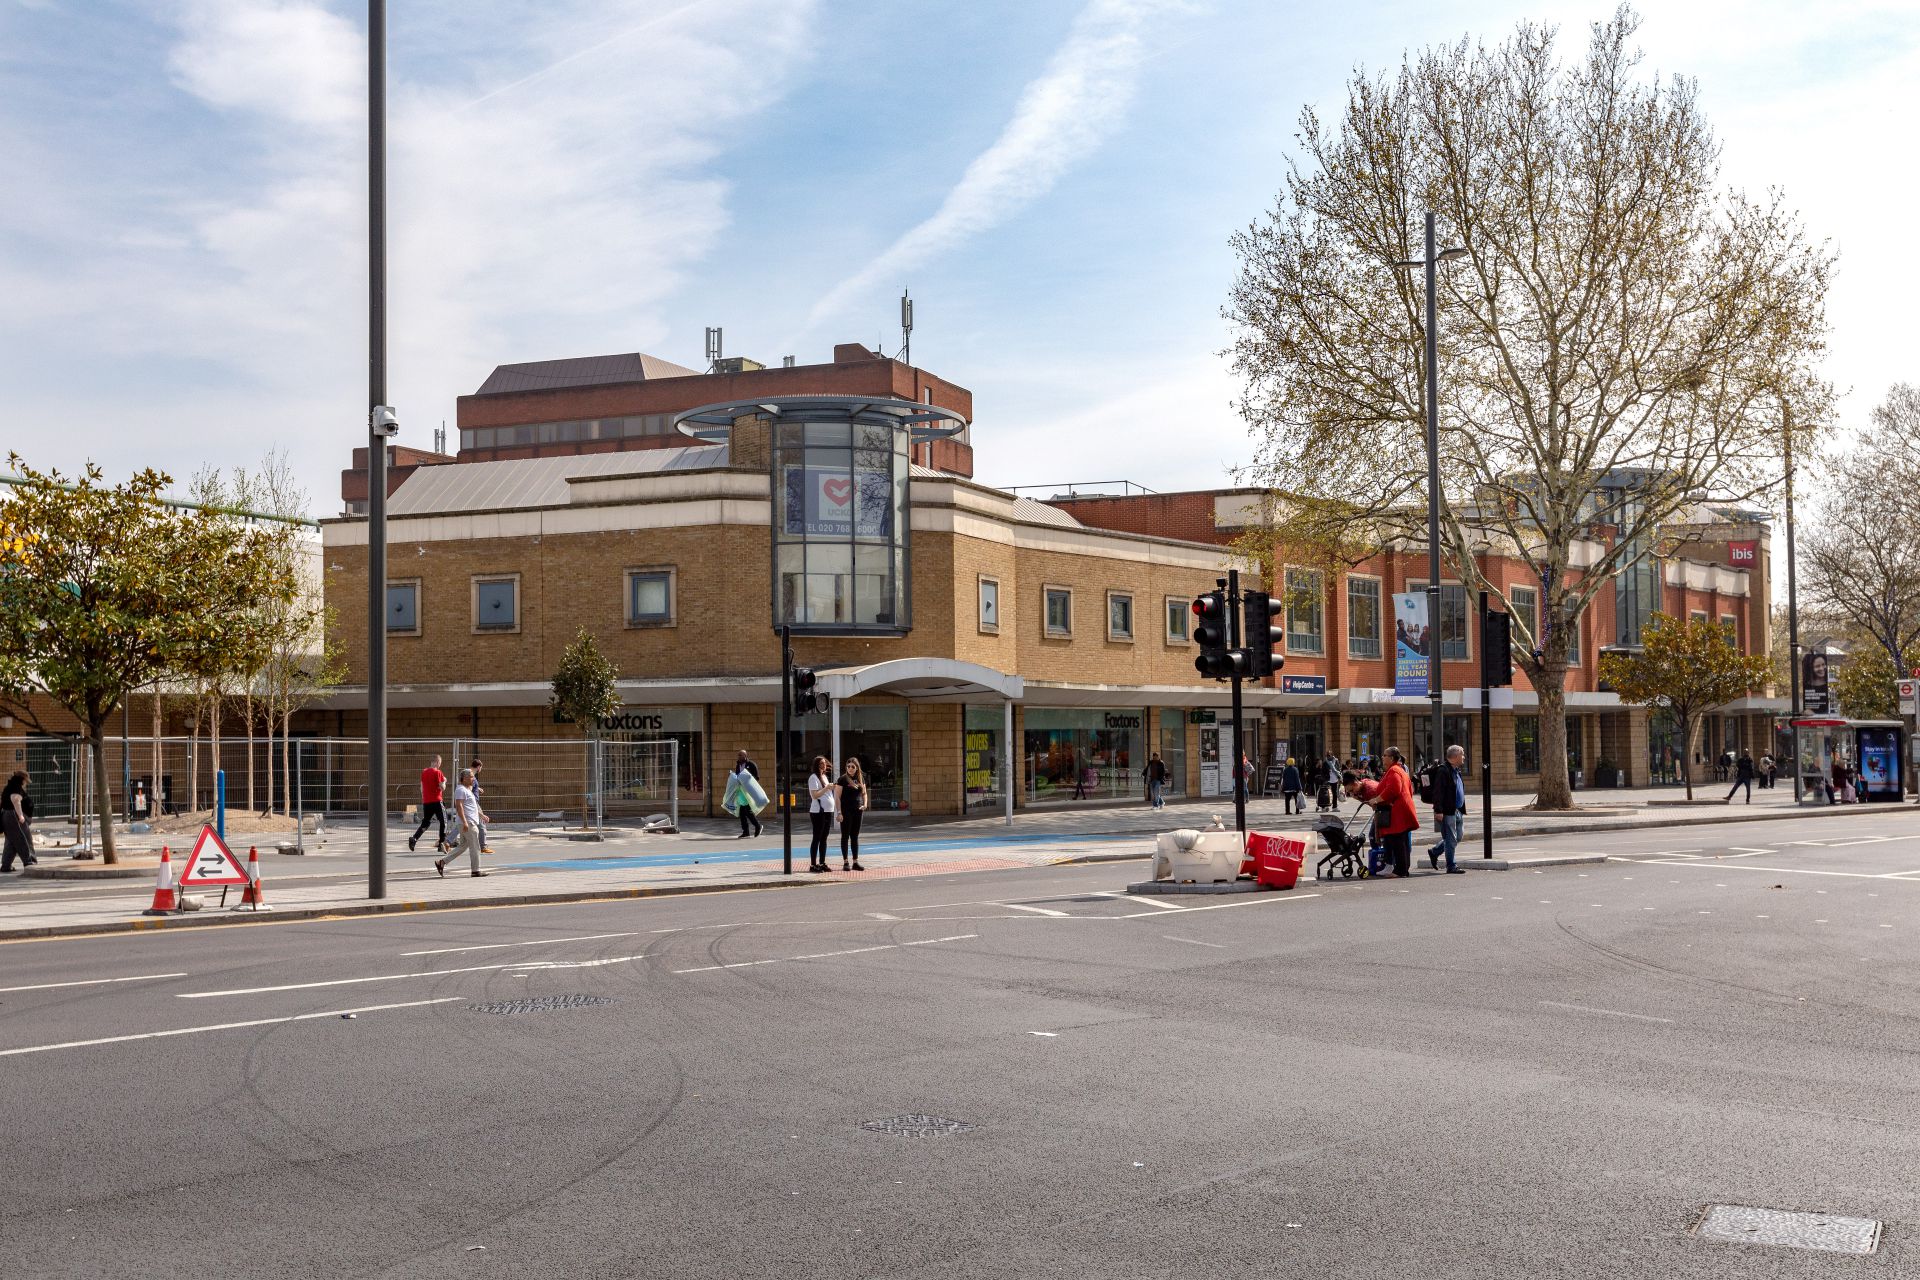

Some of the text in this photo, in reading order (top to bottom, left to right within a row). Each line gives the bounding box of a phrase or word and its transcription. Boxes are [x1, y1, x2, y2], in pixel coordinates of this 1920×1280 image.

[807, 524, 816, 532] EL
[818, 524, 833, 532] 020
[836, 525, 850, 533] 768
[1732, 548, 1753, 560] ibis
[1397, 670, 1428, 678] ROUND
[1105, 712, 1140, 729] Foxtons
[966, 733, 988, 751] MOVERS
[966, 752, 980, 769] NEED
[966, 770, 991, 788] SHAKERS
